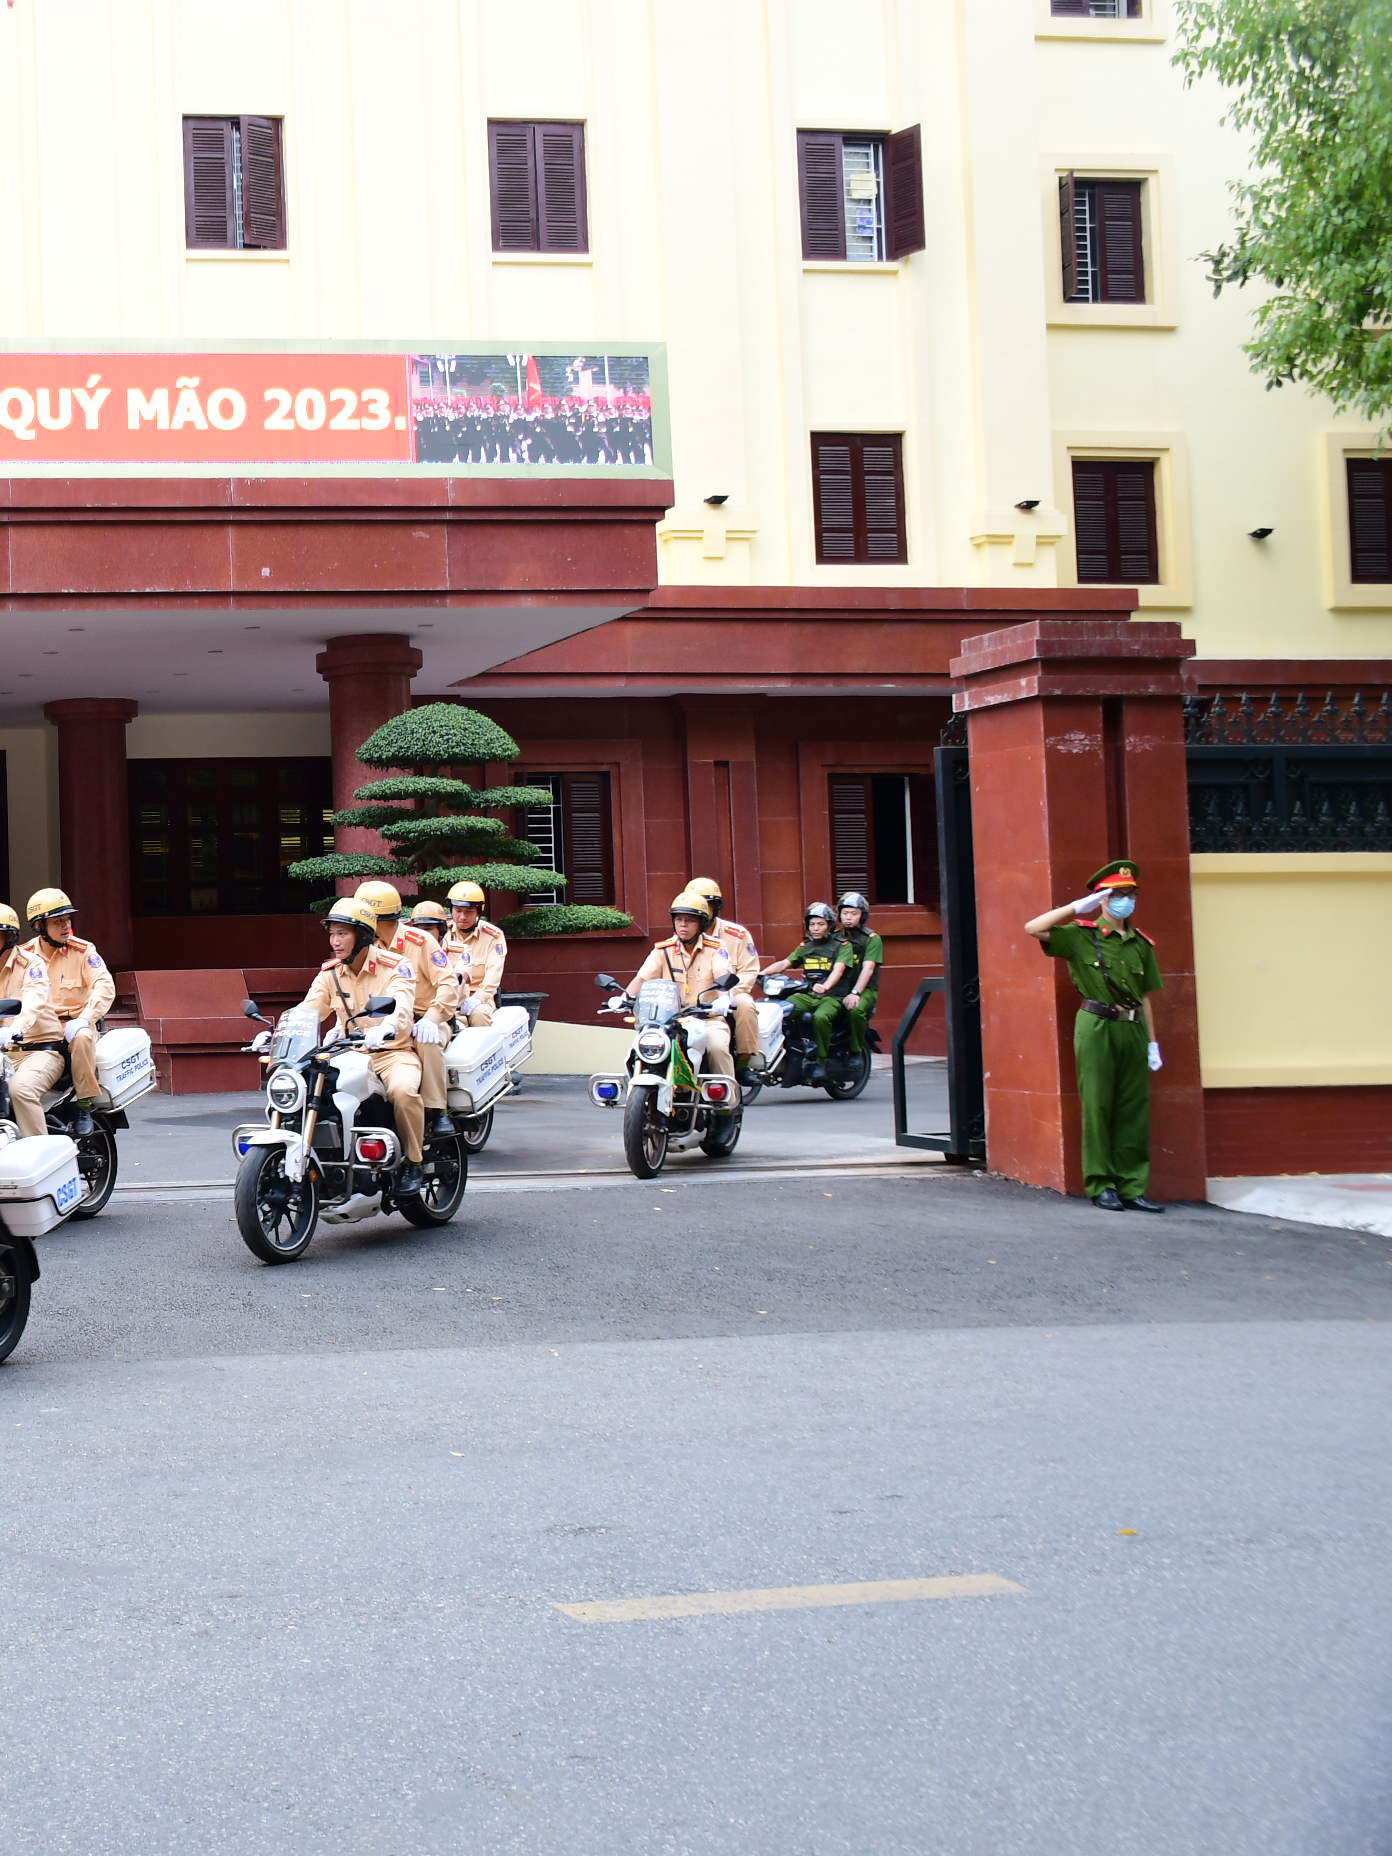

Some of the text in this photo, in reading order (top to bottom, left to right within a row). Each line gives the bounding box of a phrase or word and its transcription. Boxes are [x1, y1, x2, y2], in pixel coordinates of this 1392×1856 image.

[127, 377, 247, 431] MÃO
[263, 388, 406, 430] 2023.
[122, 1052, 140, 1069] CSGT
[480, 1052, 497, 1071] CSGT
[57, 1177, 78, 1207] CSGT
